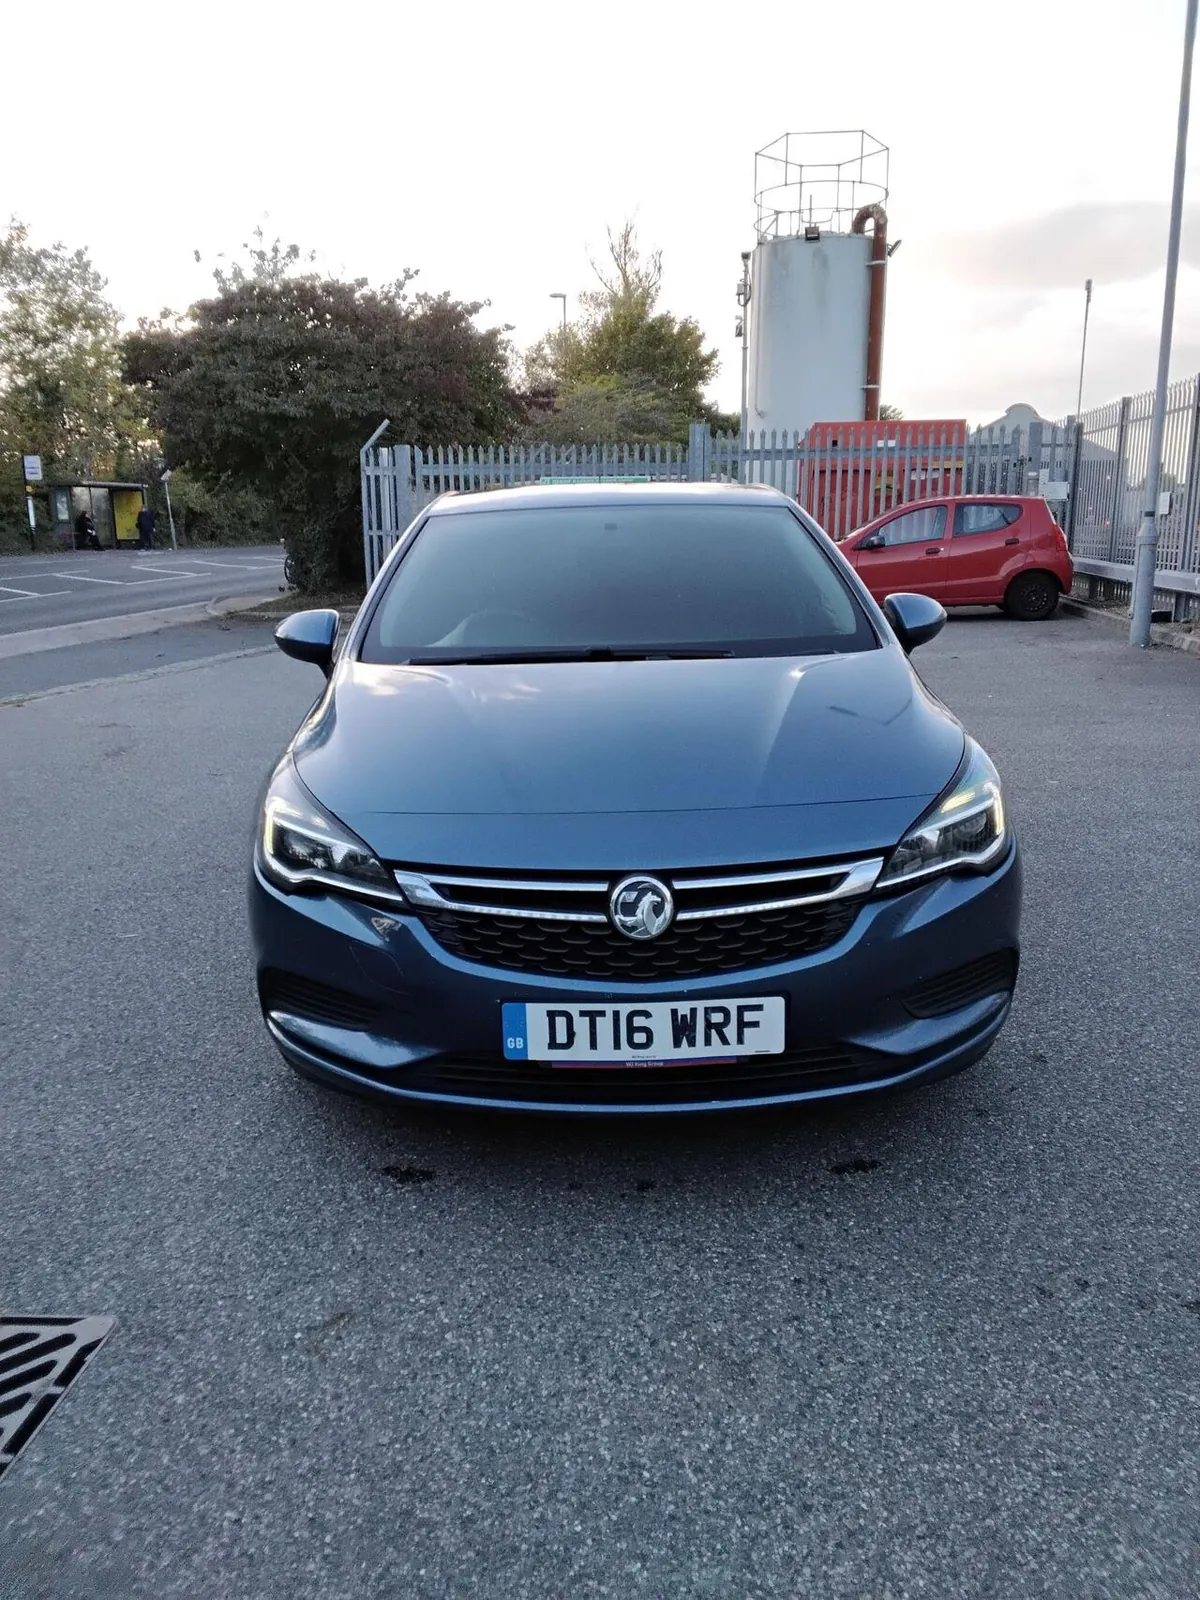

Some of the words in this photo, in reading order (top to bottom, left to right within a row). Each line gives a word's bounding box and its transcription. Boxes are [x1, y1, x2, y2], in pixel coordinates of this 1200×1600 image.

[546, 1009, 653, 1051] DT16
[671, 1003, 764, 1049] WRF
[507, 1037, 524, 1049] GB
